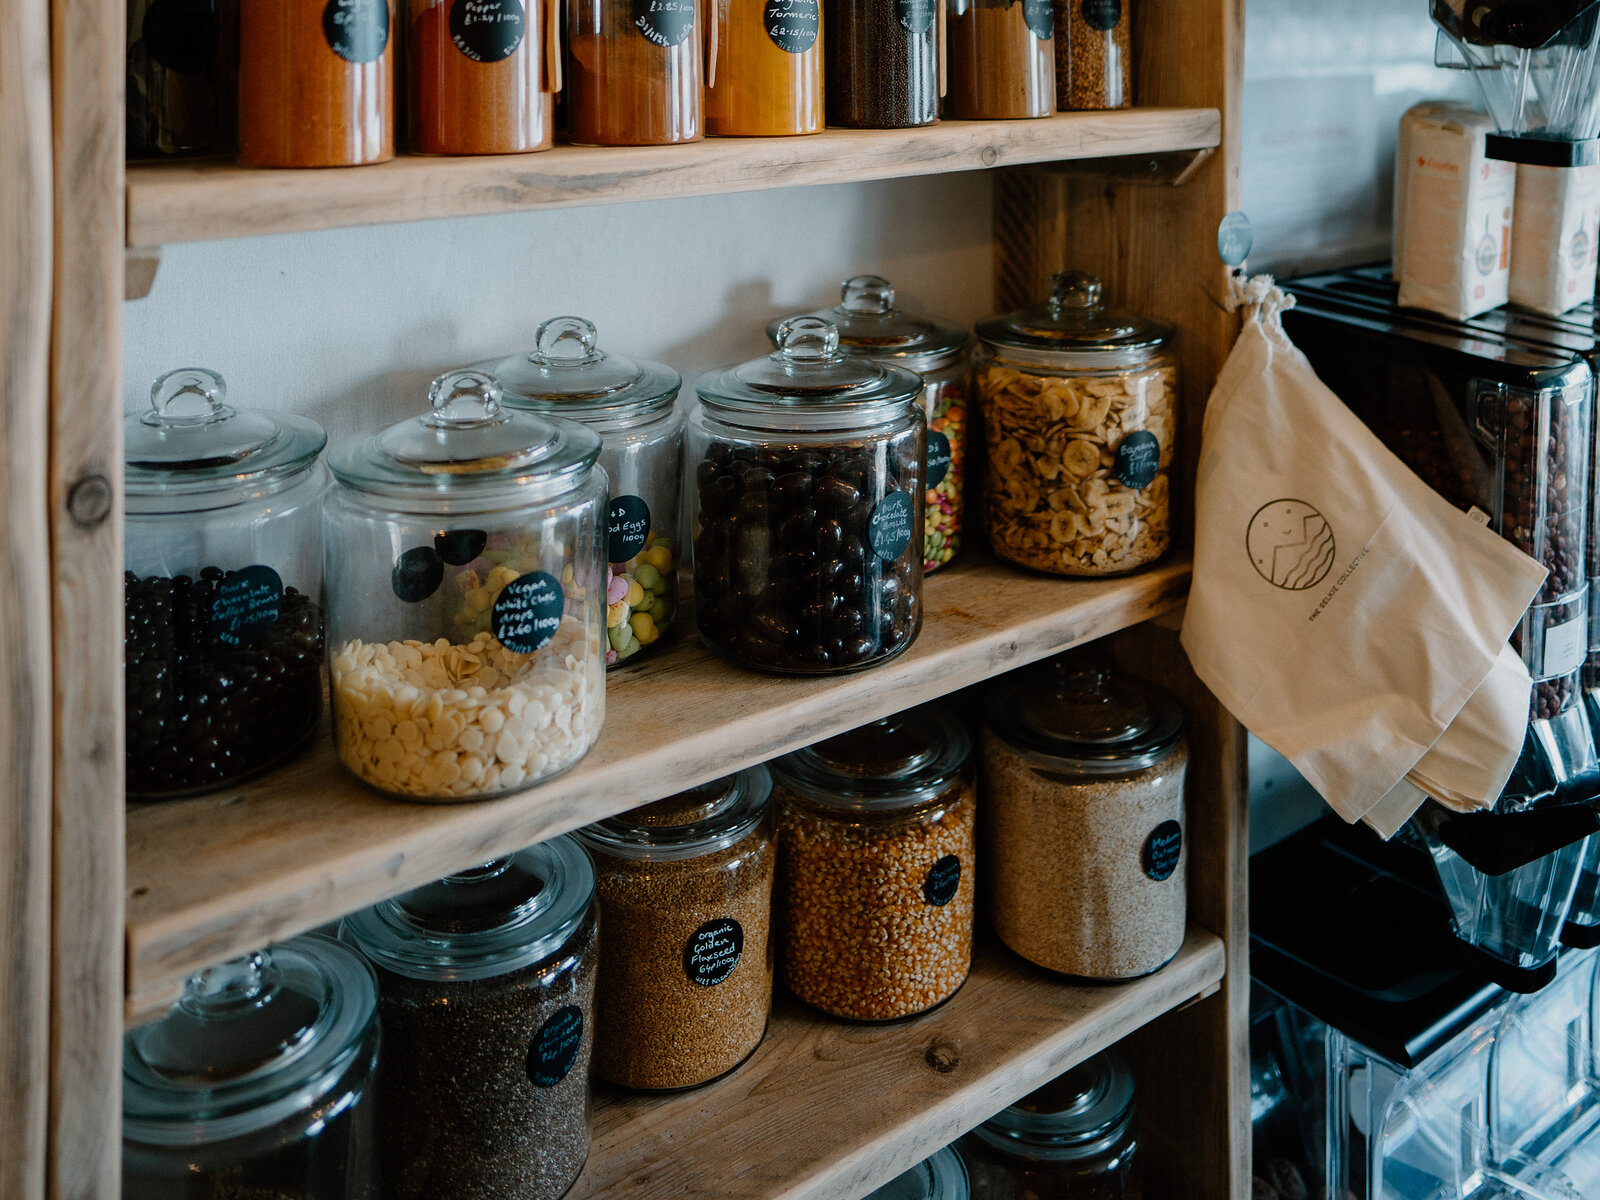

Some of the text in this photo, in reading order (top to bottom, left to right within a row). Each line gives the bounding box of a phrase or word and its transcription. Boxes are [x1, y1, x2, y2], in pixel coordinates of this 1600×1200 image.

[465, 1, 502, 14] Pepper
[623, 519, 646, 534] Eggs
[508, 579, 547, 599] Vegan
[1308, 608, 1321, 622] THE
[1337, 547, 1370, 586] COLLECTIVE
[691, 942, 735, 965] Flaxseed
[694, 938, 729, 954] Golden
